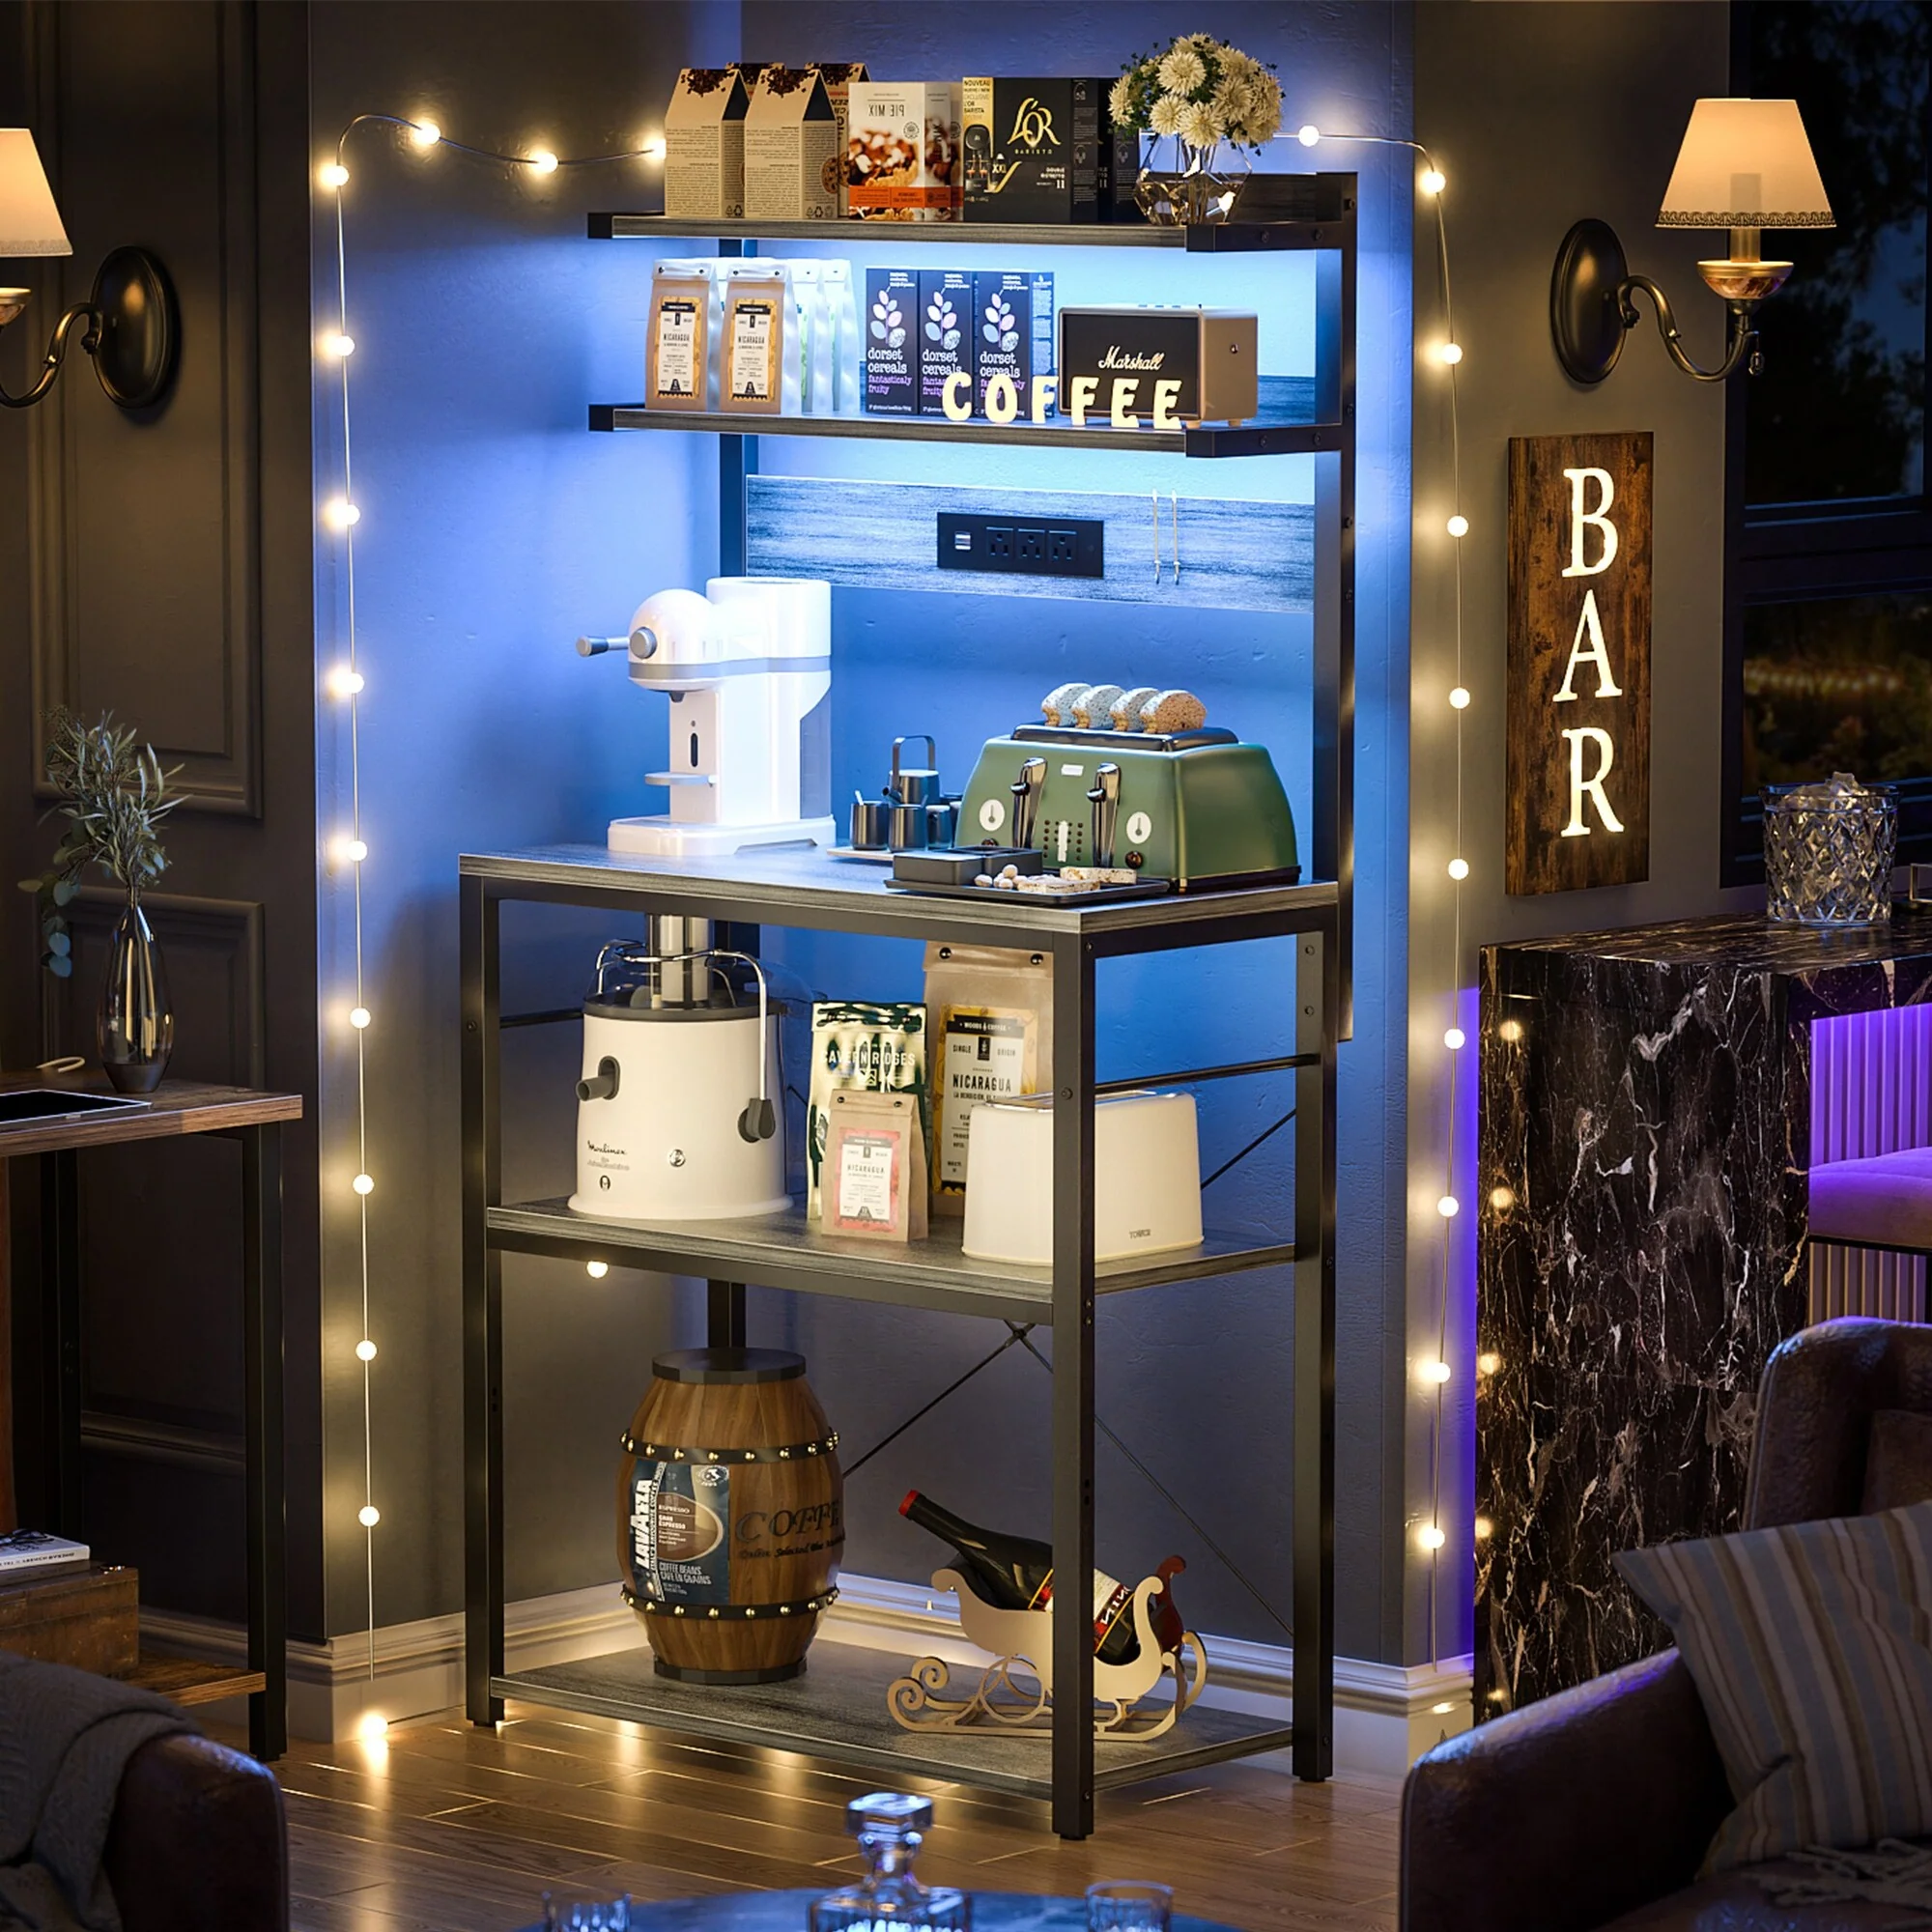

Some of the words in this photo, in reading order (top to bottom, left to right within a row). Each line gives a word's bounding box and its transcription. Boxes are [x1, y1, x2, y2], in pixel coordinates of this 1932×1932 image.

[1007, 98, 1062, 148] L'OR
[867, 347, 903, 360] dorset
[922, 349, 958, 362] dorset
[980, 352, 1016, 365] dorset
[1097, 345, 1165, 371] Marshall
[867, 362, 908, 374] cereals
[922, 364, 962, 376] cereals
[980, 365, 1021, 378] cereals
[941, 371, 1183, 430] COFFEE
[1551, 467, 1625, 838] BAR
[952, 1044, 972, 1054] SINGLE
[952, 1073, 1011, 1093] NICARAGUA
[847, 1164, 886, 1175] NICARAGUA
[630, 1479, 653, 1570] LAVAZZA
